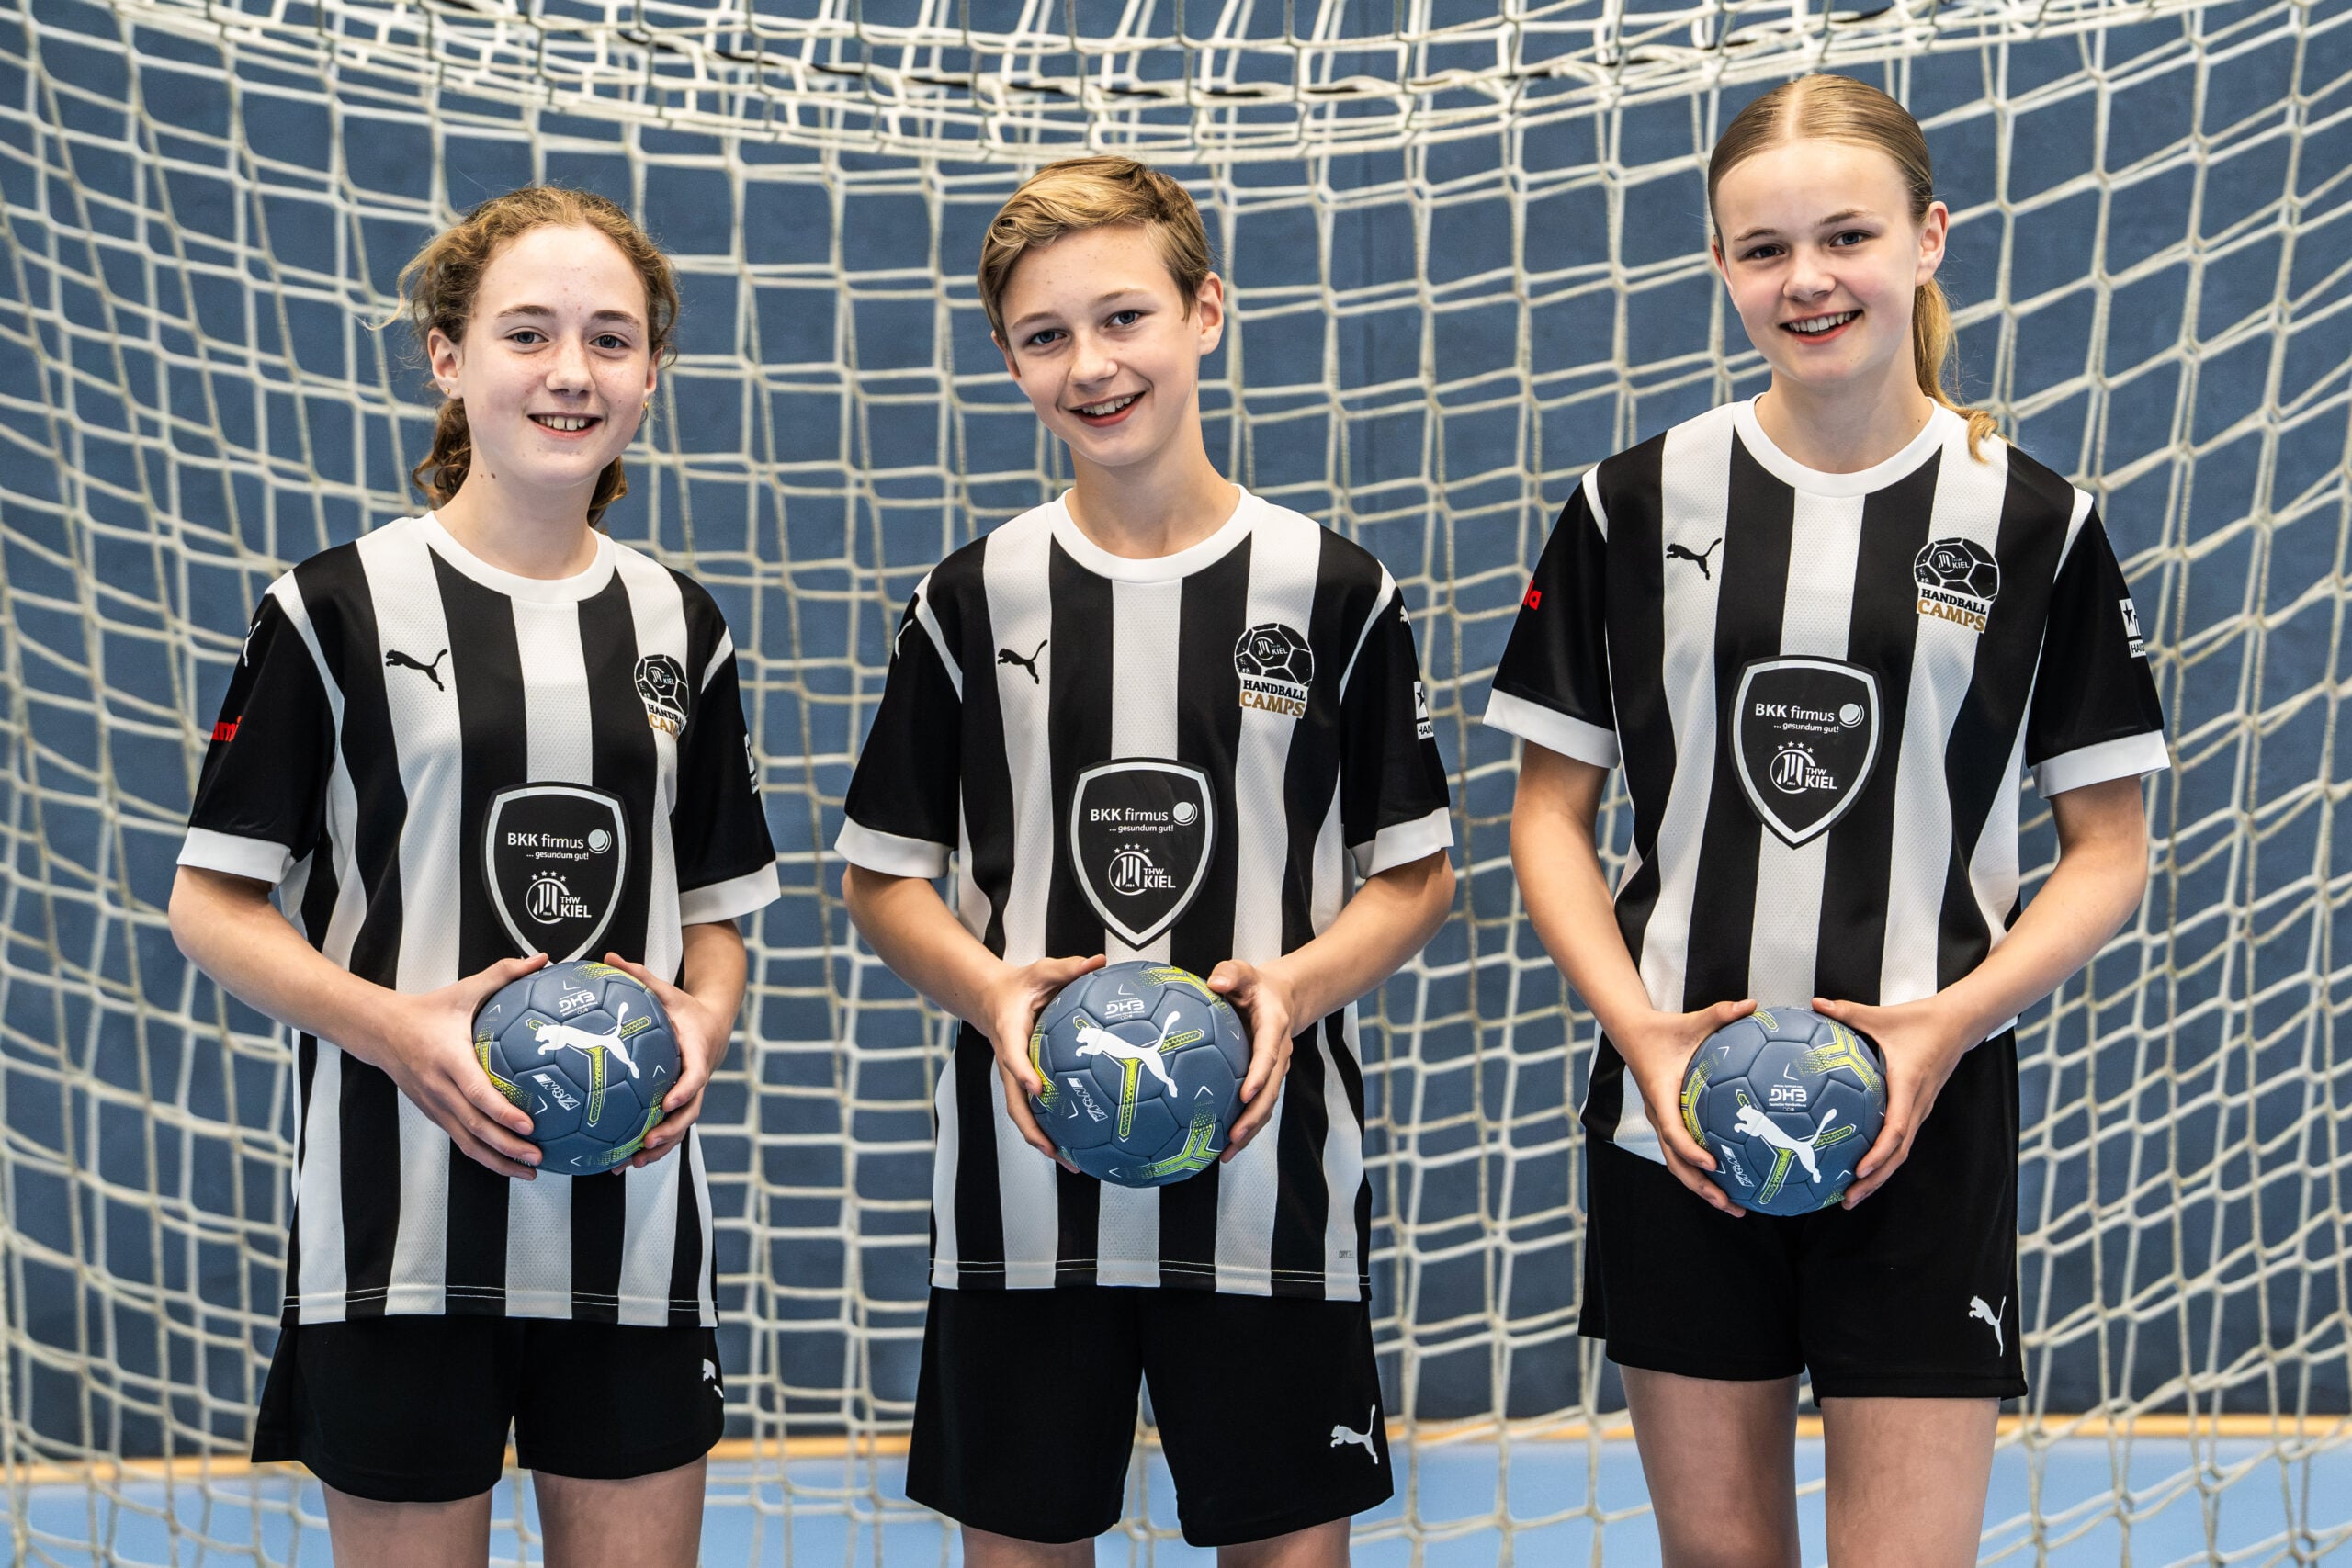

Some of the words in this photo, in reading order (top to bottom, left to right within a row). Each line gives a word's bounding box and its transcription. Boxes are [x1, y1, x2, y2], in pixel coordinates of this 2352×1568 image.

[1921, 588, 1986, 615] HANDBALL
[1917, 599, 1986, 632] CAMPS
[1242, 679, 1306, 702] HANDBALL
[1240, 691, 1306, 717] CAMPS
[1755, 703, 1788, 718] BKK
[1790, 705, 1835, 722] firmus
[1782, 722, 1822, 732] gesundum
[1823, 726, 1839, 734] gut!
[1805, 767, 1827, 776] THW
[1804, 775, 1838, 790] KIEL
[1090, 808, 1122, 821] BKK
[1125, 807, 1169, 821] firmus
[1117, 824, 1158, 833] gesundum
[1158, 824, 1174, 834] gut!
[507, 832, 538, 847] BKK
[541, 833, 584, 849] firmus
[535, 851, 573, 860] gesundum
[574, 852, 589, 861] gut!
[1143, 867, 1164, 875] THW
[1143, 875, 1176, 888] KIEL
[560, 896, 581, 904] THW
[560, 904, 592, 918] KIEL
[559, 991, 596, 1013] DHB
[1104, 999, 1145, 1016] DHB
[1768, 1088, 1807, 1102] DHB
